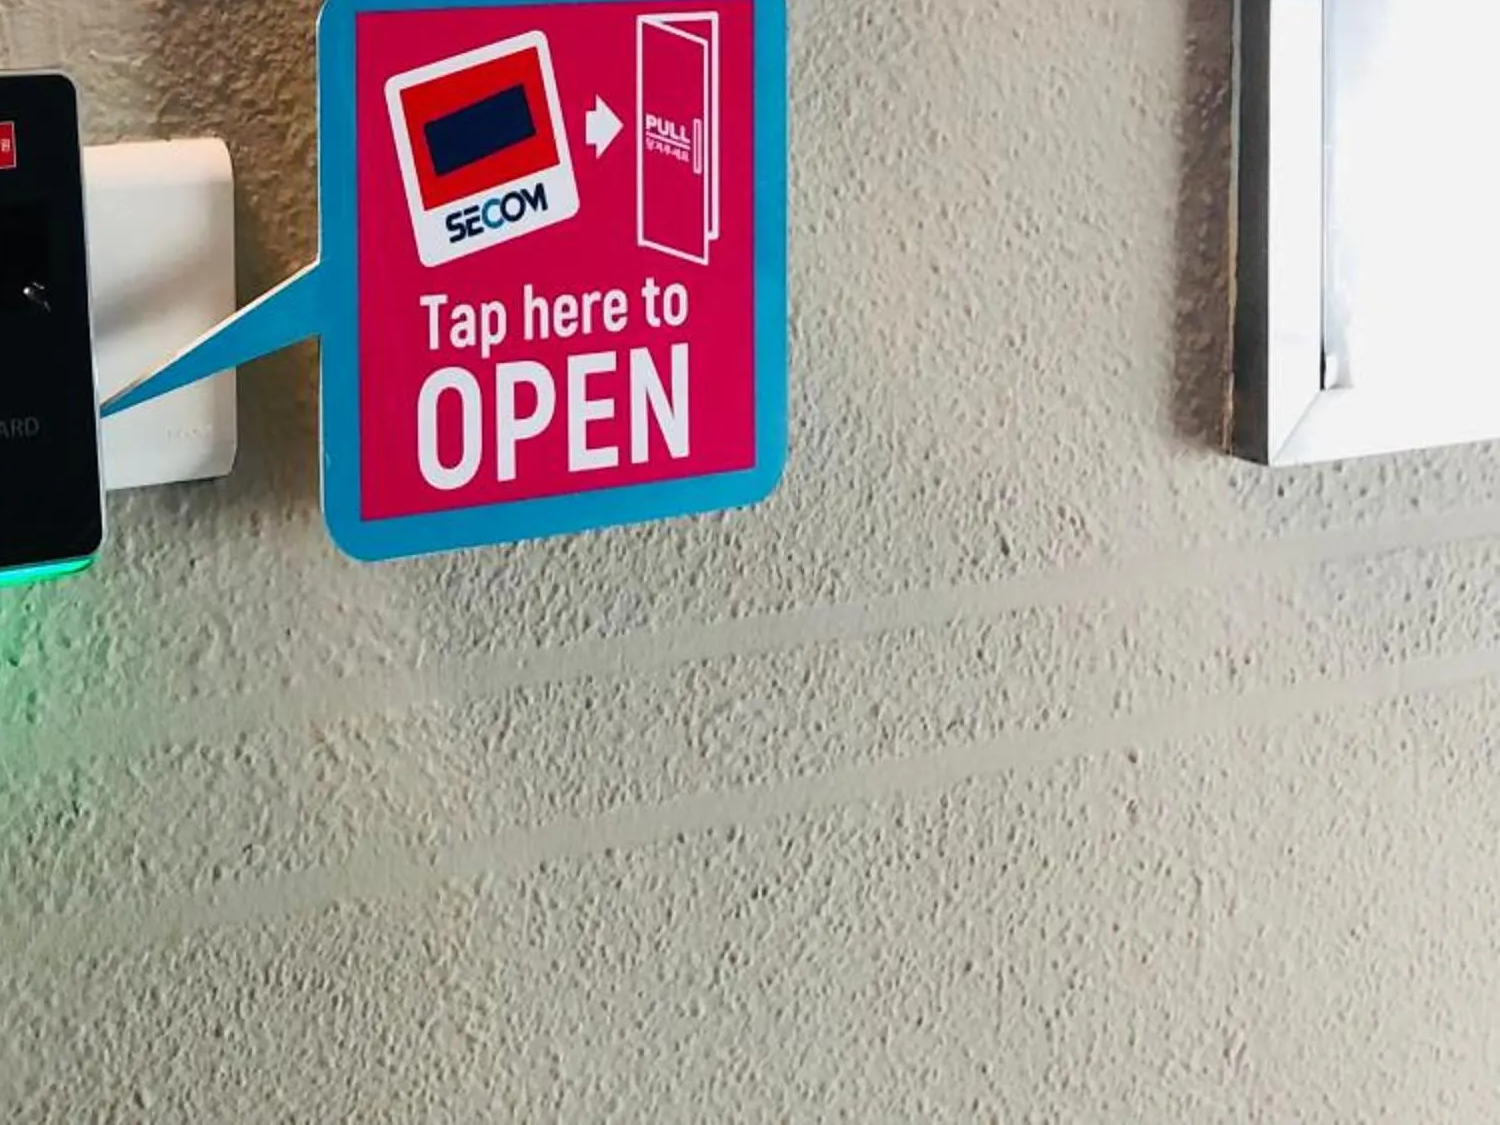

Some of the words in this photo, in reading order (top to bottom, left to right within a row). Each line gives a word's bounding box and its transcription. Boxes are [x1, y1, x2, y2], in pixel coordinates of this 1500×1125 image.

[645, 113, 690, 144] PULL
[445, 182, 549, 244] SECOM
[419, 293, 507, 358] Tap
[522, 284, 629, 341] here
[641, 277, 688, 327] to
[416, 342, 690, 491] OPEN
